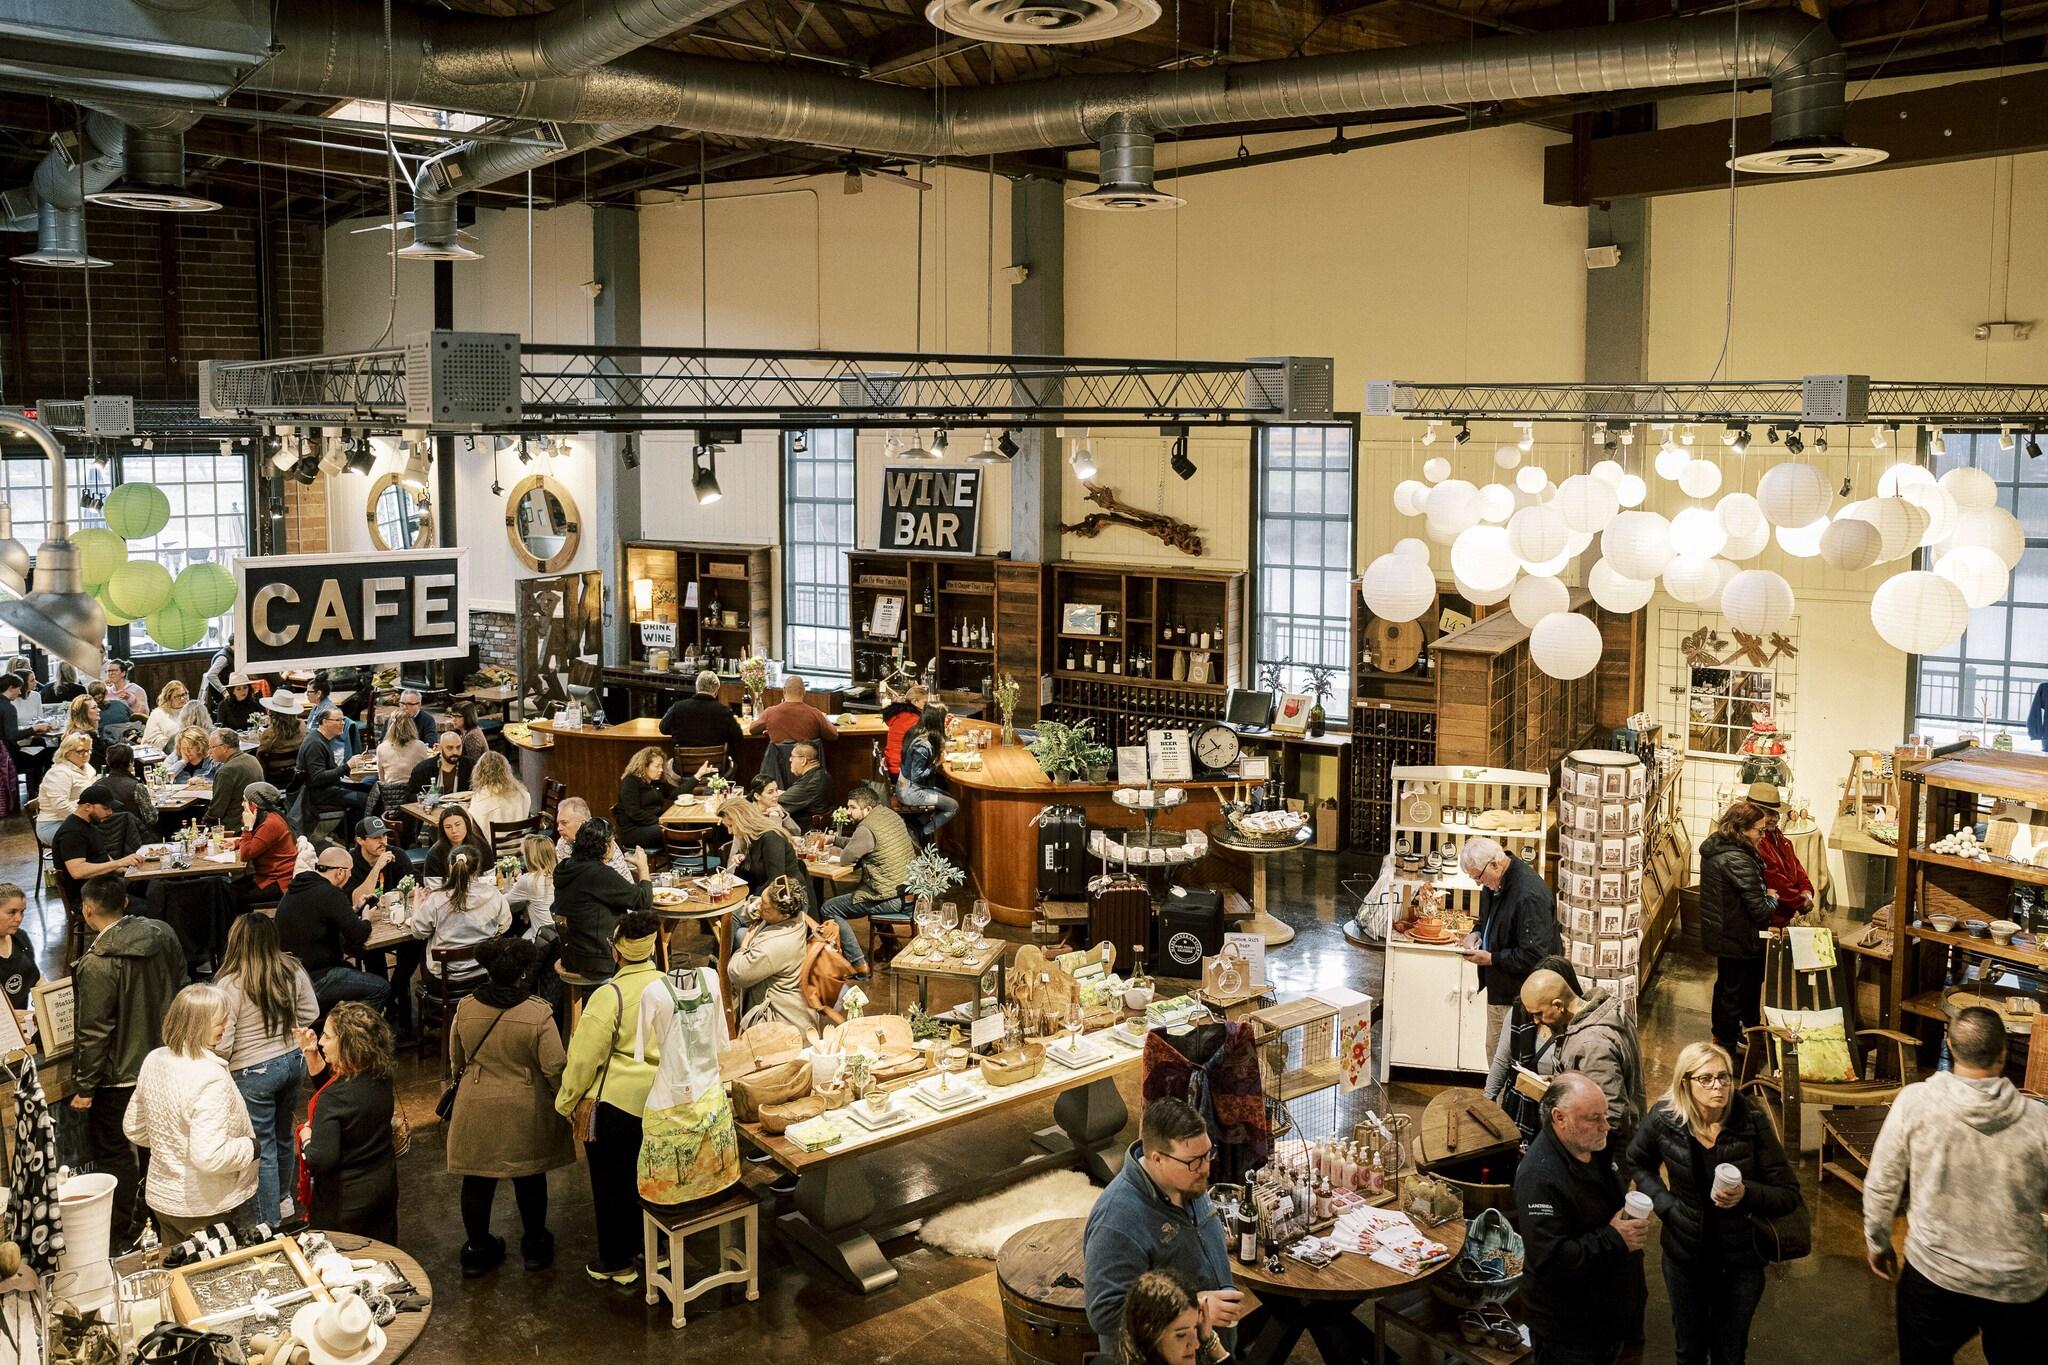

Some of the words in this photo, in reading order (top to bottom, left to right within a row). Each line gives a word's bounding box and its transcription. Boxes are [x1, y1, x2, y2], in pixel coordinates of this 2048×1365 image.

[886, 471, 976, 507] WINE
[894, 512, 960, 547] BAR
[252, 574, 456, 647] CAFE
[1163, 732, 1173, 740] B
[54, 998, 75, 1009] Statio
